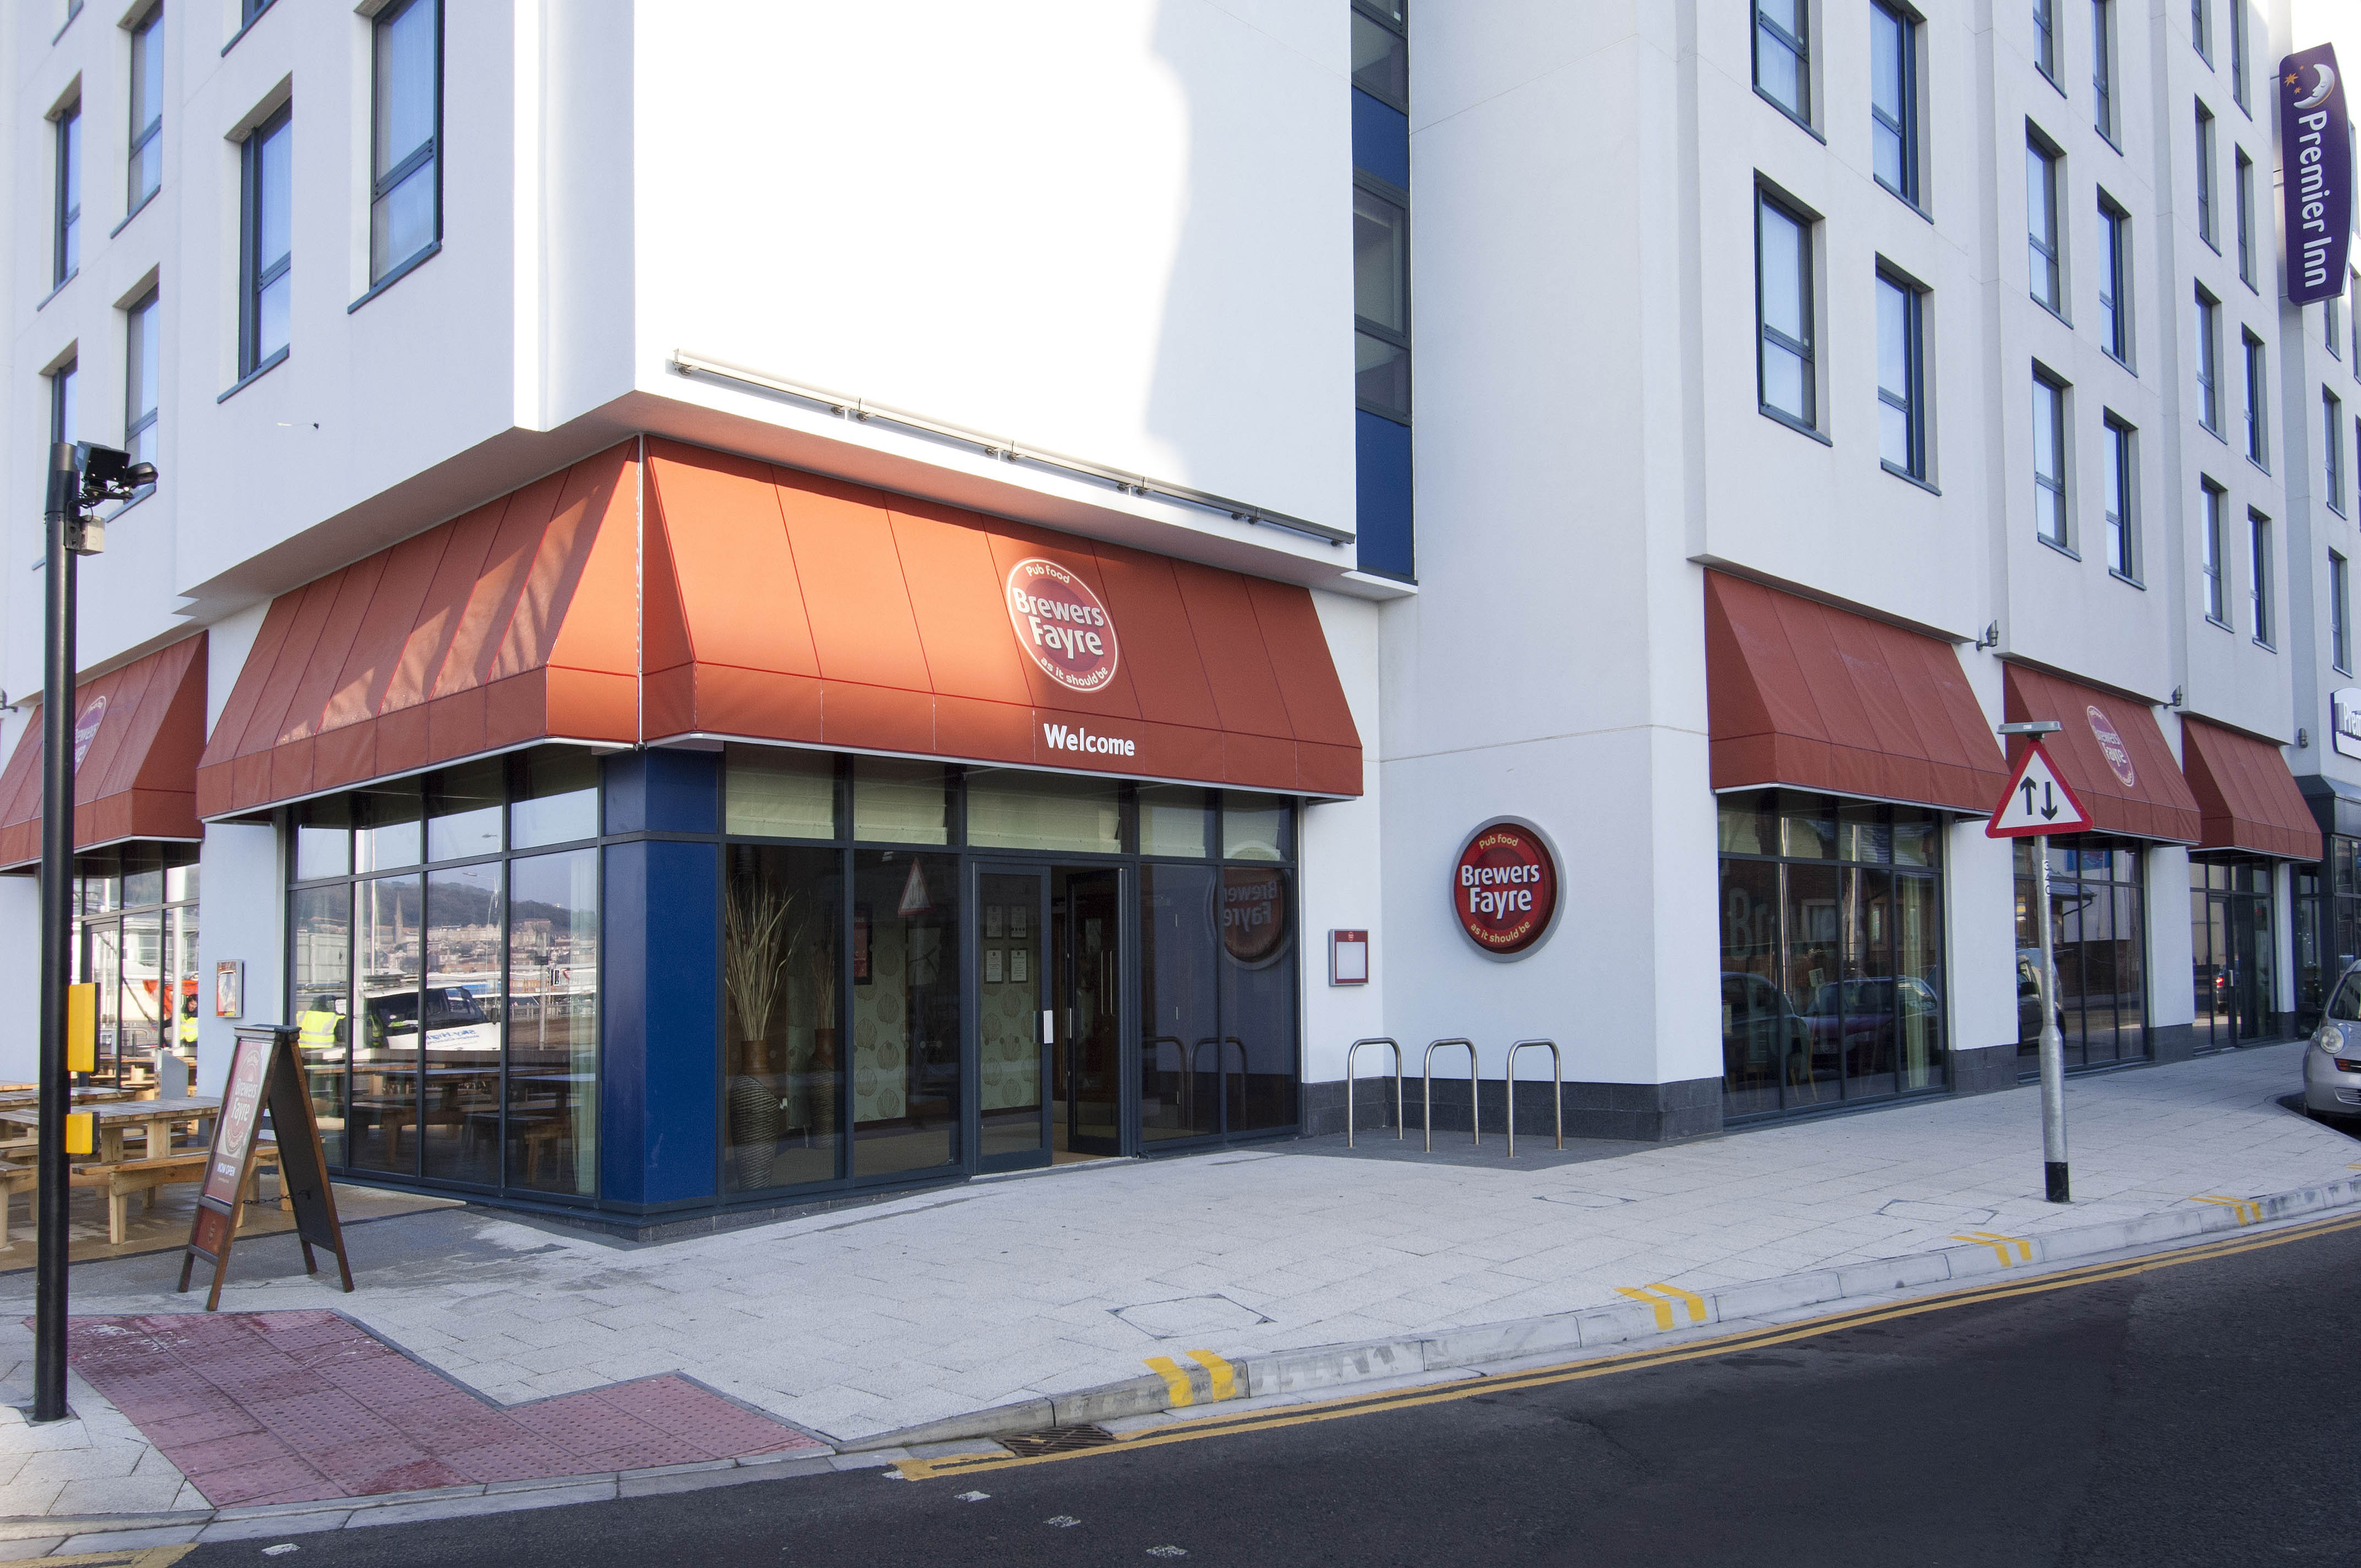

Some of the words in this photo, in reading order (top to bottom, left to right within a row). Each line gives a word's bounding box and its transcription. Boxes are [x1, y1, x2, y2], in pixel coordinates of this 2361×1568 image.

[2298, 110, 2330, 233] Premier
[2303, 236, 2332, 287] Inn
[1012, 587, 1105, 627] Brewers
[1028, 616, 1104, 660] Fayre
[1041, 657, 1053, 672] as
[1056, 667, 1064, 679] it
[1066, 673, 1097, 686] should
[1096, 667, 1108, 679] be
[1043, 723, 1135, 756] Welcome
[2101, 742, 2126, 767] Fayre
[1461, 864, 1540, 887] Brewers
[1470, 887, 1532, 920] Fayre
[1471, 923, 1481, 935] as
[1481, 930, 1488, 940] it
[1489, 929, 1519, 943] should
[1519, 921, 1530, 933] be
[235, 1077, 258, 1098] Brewers
[231, 1097, 251, 1126] Fayre
